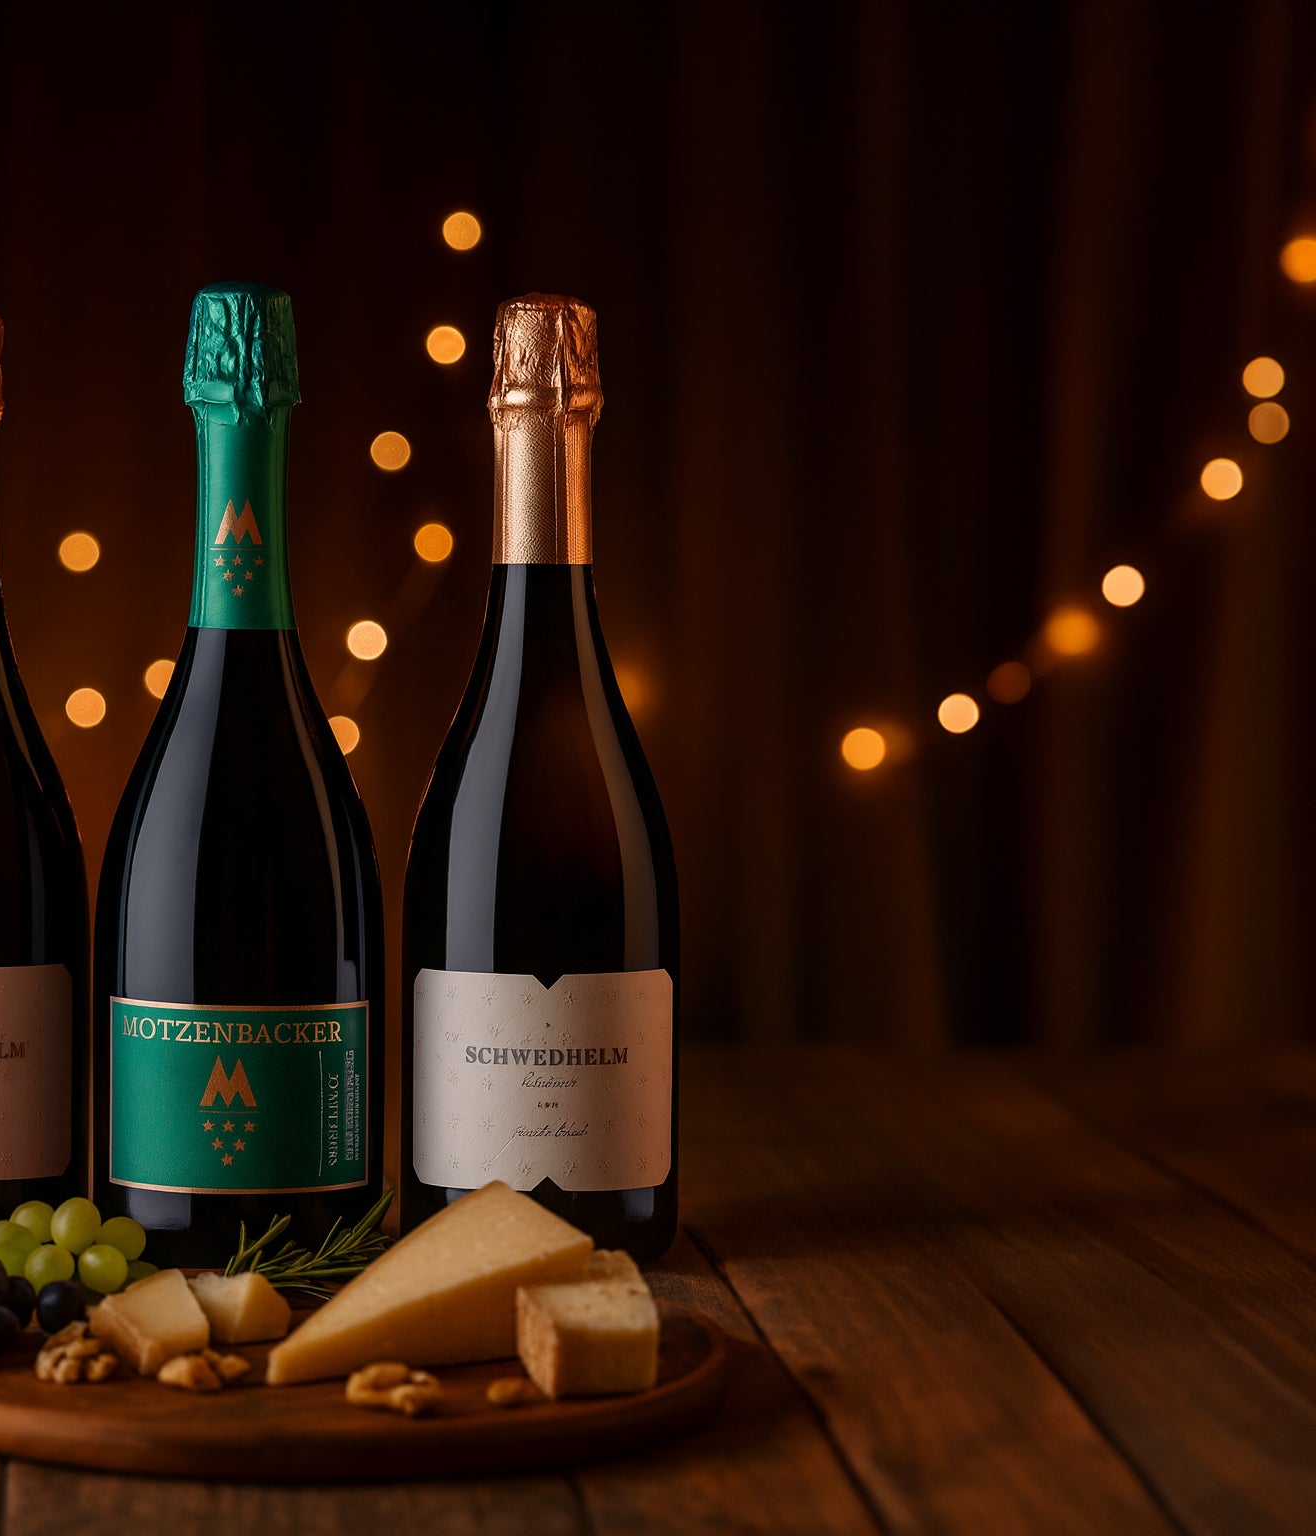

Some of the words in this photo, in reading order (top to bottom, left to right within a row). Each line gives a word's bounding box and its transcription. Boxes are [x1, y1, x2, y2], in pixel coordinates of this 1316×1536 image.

[214, 498, 263, 545] M
[122, 1015, 343, 1044] MOTZENBACKER
[465, 1045, 629, 1066] SCHWEDHELM
[199, 1055, 257, 1107] M
